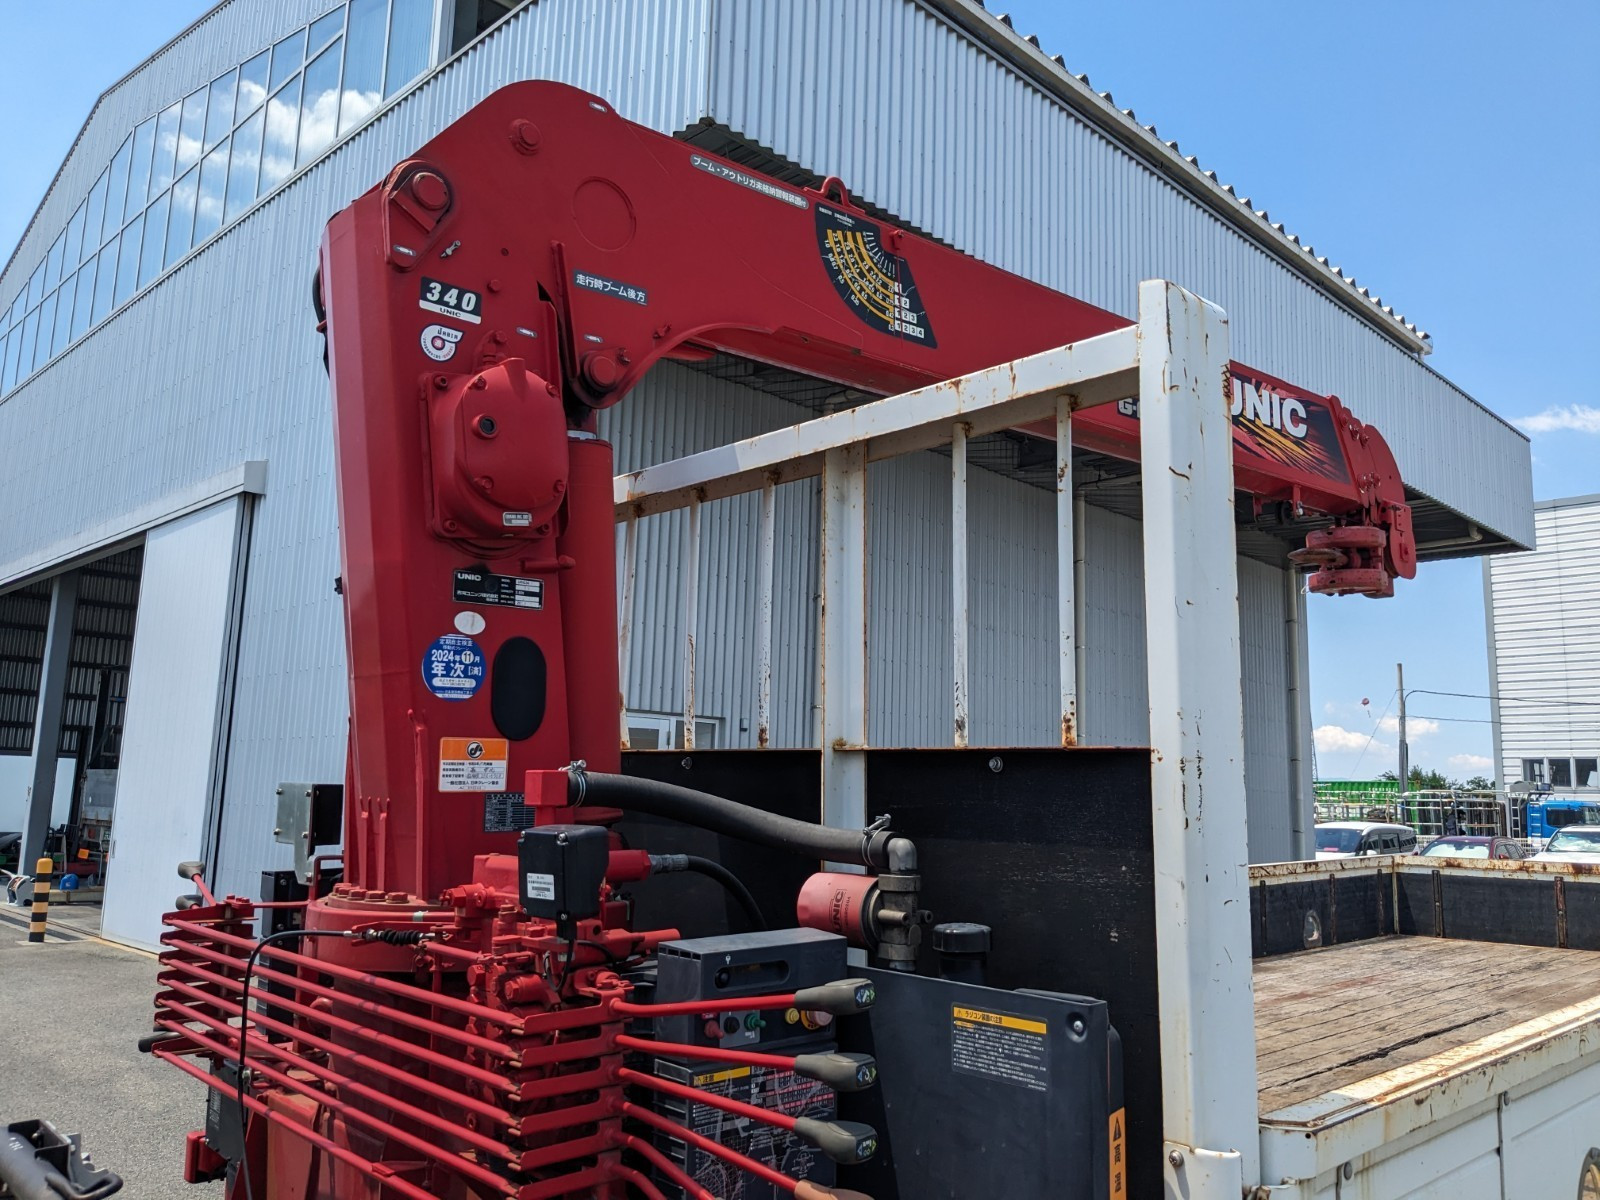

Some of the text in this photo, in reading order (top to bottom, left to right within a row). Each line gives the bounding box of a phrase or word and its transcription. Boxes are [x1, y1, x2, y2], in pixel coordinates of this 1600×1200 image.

[426, 282, 477, 311] 340
[576, 273, 646, 302] 走行時ブーム後方
[439, 307, 462, 318] UNIC
[457, 572, 482, 582] UNIC
[832, 890, 844, 932] UNIC
